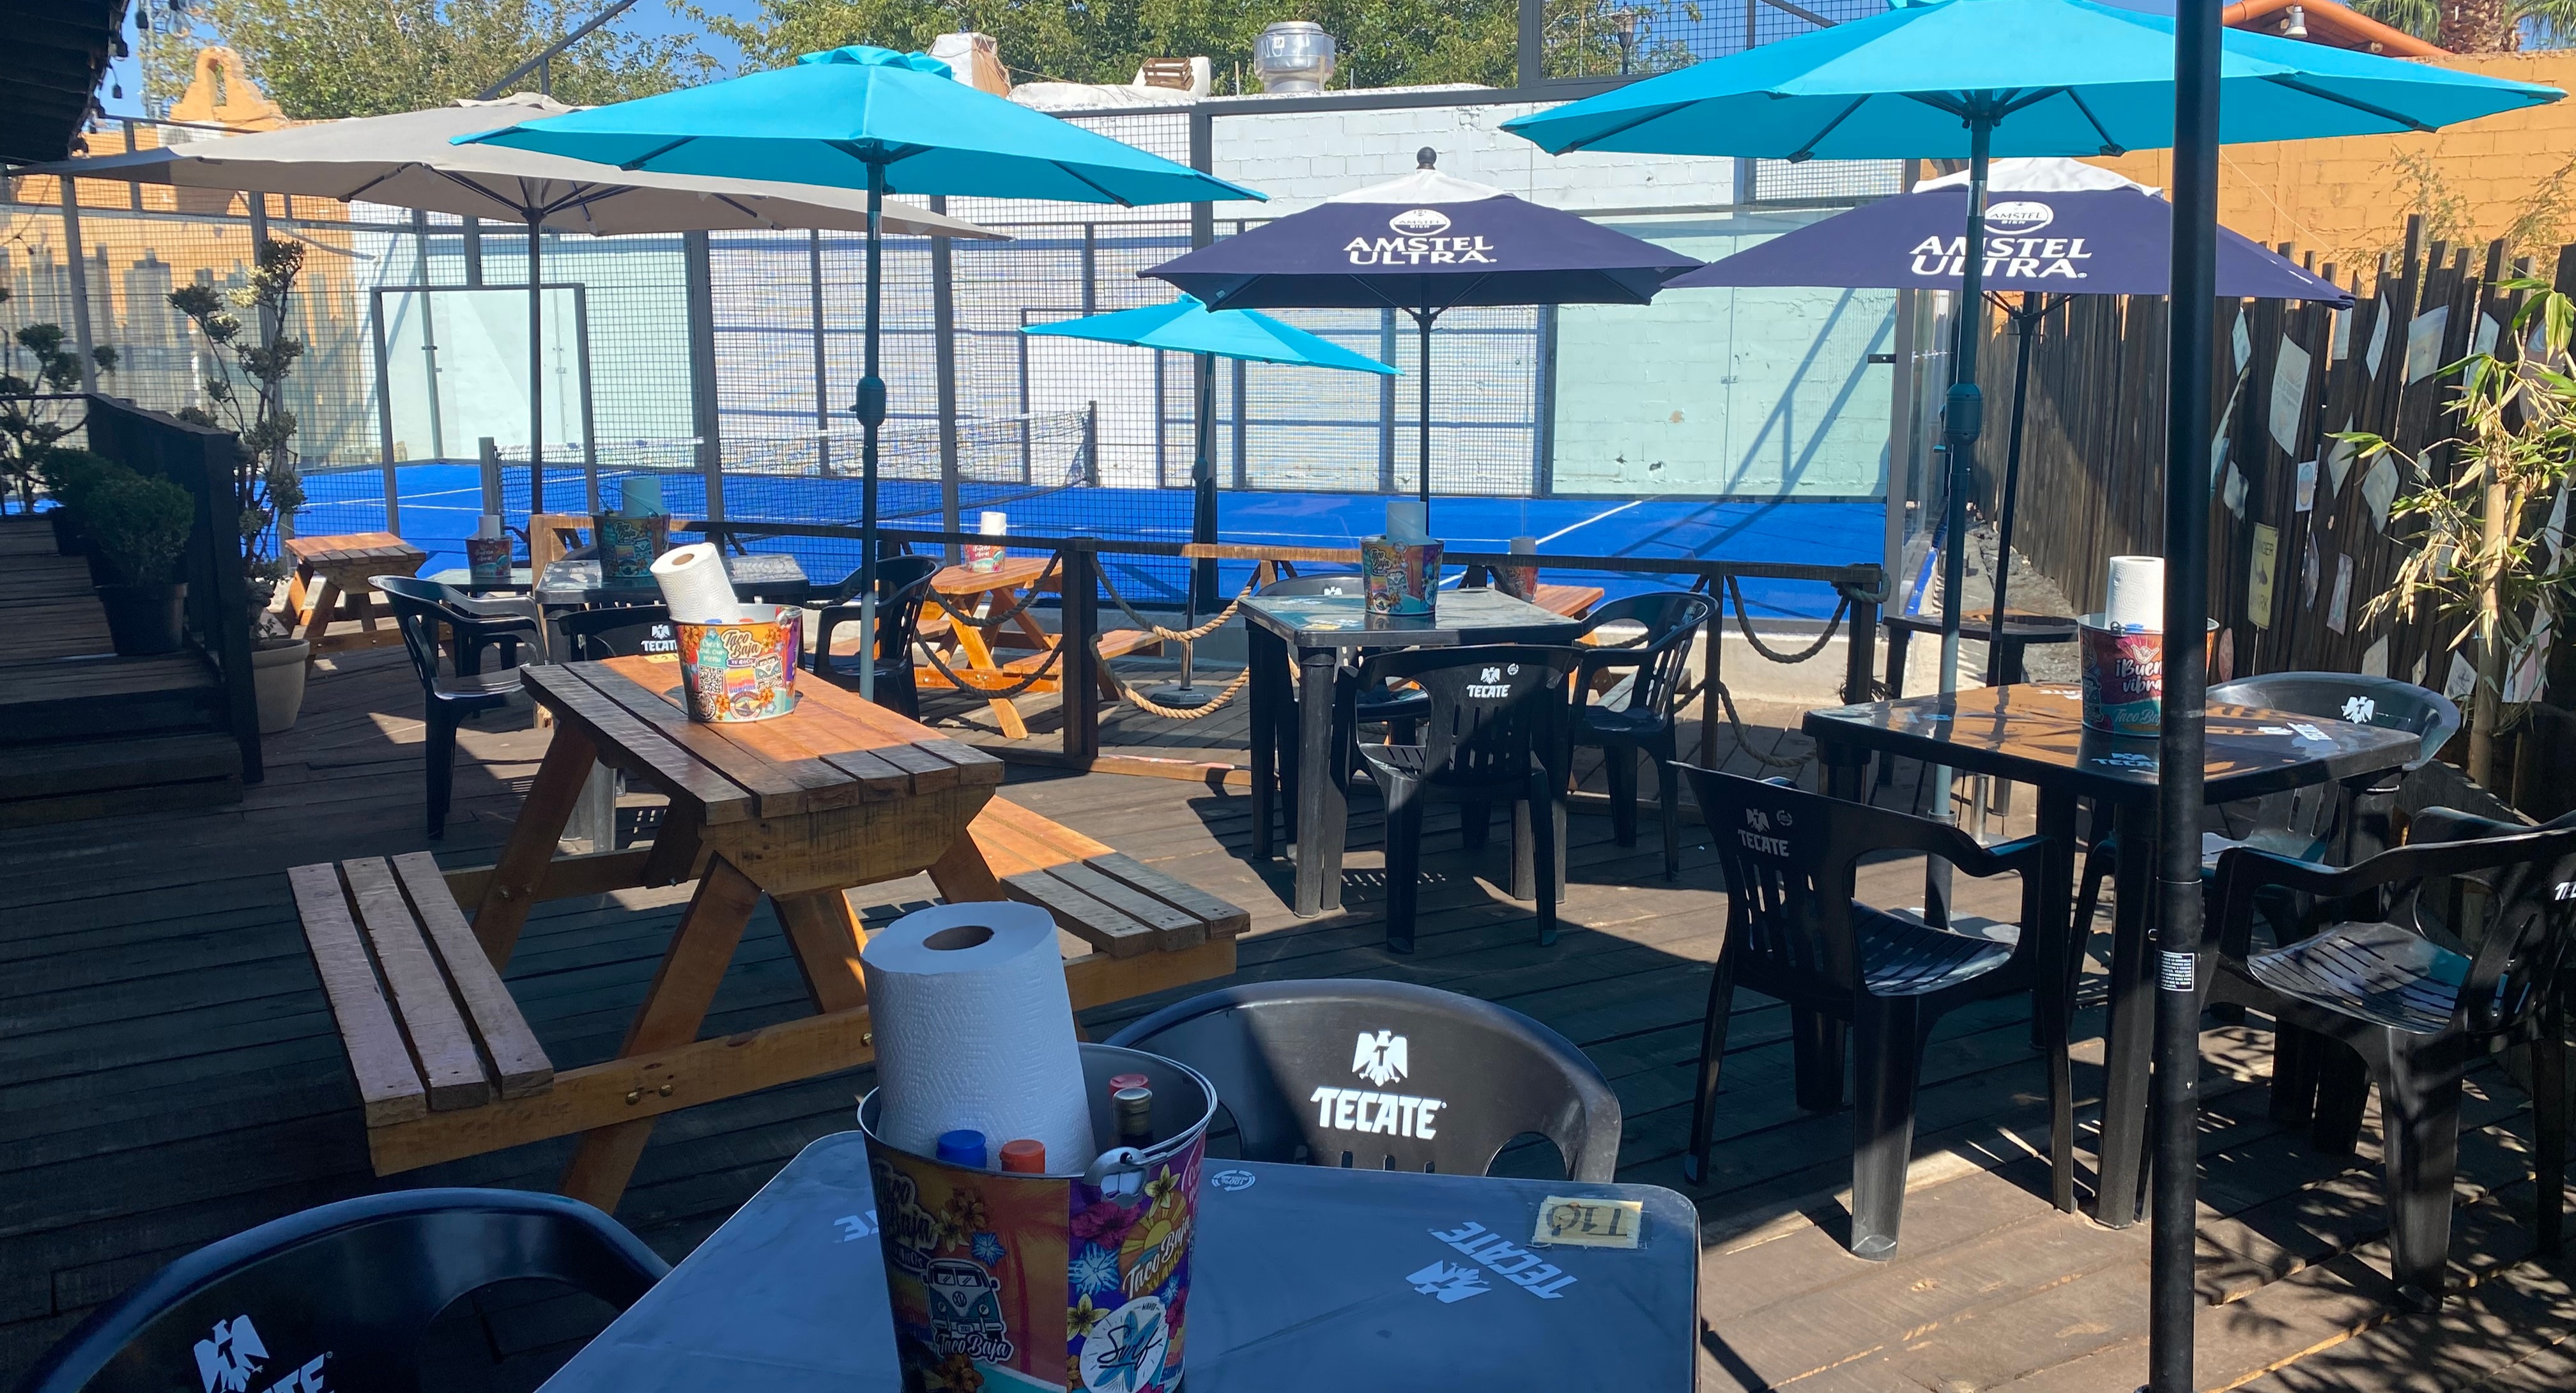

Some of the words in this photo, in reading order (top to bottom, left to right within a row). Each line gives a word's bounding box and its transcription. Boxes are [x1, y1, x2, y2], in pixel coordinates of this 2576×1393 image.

[1343, 236, 1494, 252] AMSTEL
[1909, 236, 2092, 258] AMSTEL
[1349, 250, 1490, 265] ULTRA
[1911, 254, 2078, 278] ULTRA
[641, 639, 677, 651] TECAT
[723, 631, 750, 647] Taco
[730, 642, 759, 658] Baja
[2116, 658, 2161, 677] ¡Buen
[1466, 684, 1511, 698] TECATE
[2122, 675, 2161, 694] vibra
[2113, 709, 2138, 723] Taco
[2140, 709, 2161, 726] Ba
[2090, 758, 2159, 767] TECA
[1738, 829, 1789, 857] TECATE
[1310, 1086, 1442, 1140] TECATE
[1123, 1252, 1160, 1299] Taco
[1160, 1215, 1190, 1264] Baja
[1430, 1221, 1577, 1299] TECATE
[937, 1334, 966, 1353] Taco
[967, 1334, 1008, 1360] Baja
[1097, 1325, 1162, 1371] Surf
